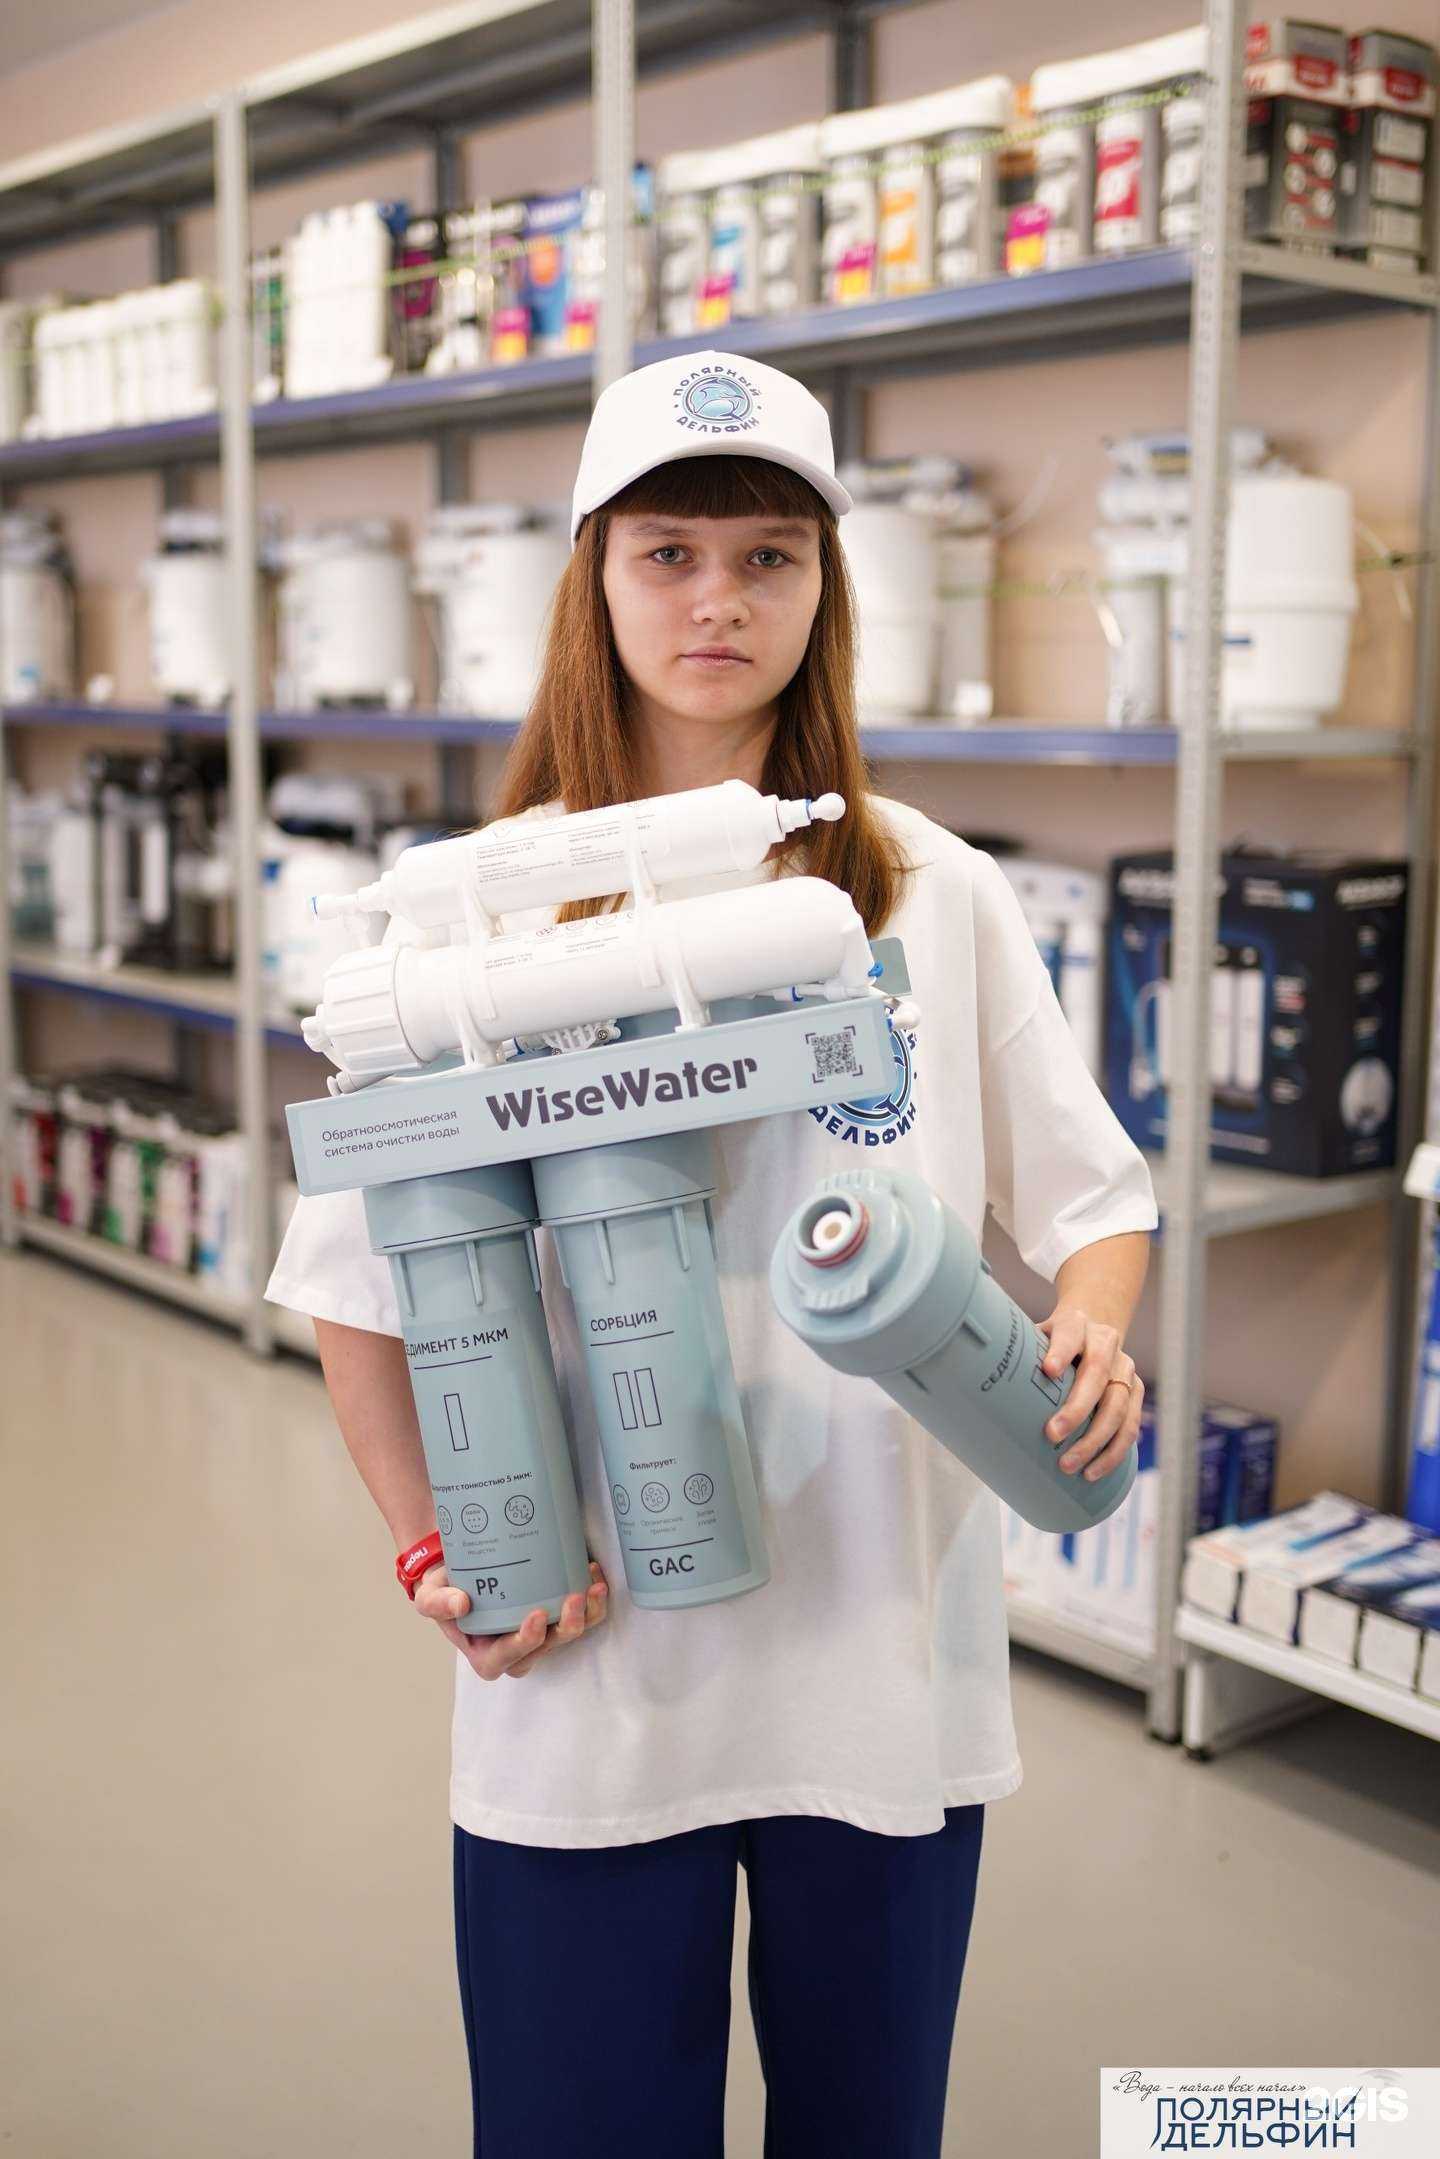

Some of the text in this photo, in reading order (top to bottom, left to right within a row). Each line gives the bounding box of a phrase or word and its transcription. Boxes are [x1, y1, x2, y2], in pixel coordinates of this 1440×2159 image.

[673, 366, 761, 396] ПОЛЯРНЫЙ
[676, 416, 760, 433] ДЕЛЬФИН
[486, 1058, 758, 1131] WiseWater
[322, 1110, 457, 1142] Обратноосмотическая
[808, 1102, 916, 1147] ДЕЛЬФИН
[325, 1127, 460, 1158] система очистки воды
[590, 1309, 657, 1331] СОРБЦИЯ
[406, 1327, 509, 1357] ЕДИМЕНТ 5 МКМ
[506, 1474, 512, 1483] 5
[649, 1554, 695, 1576] GAC
